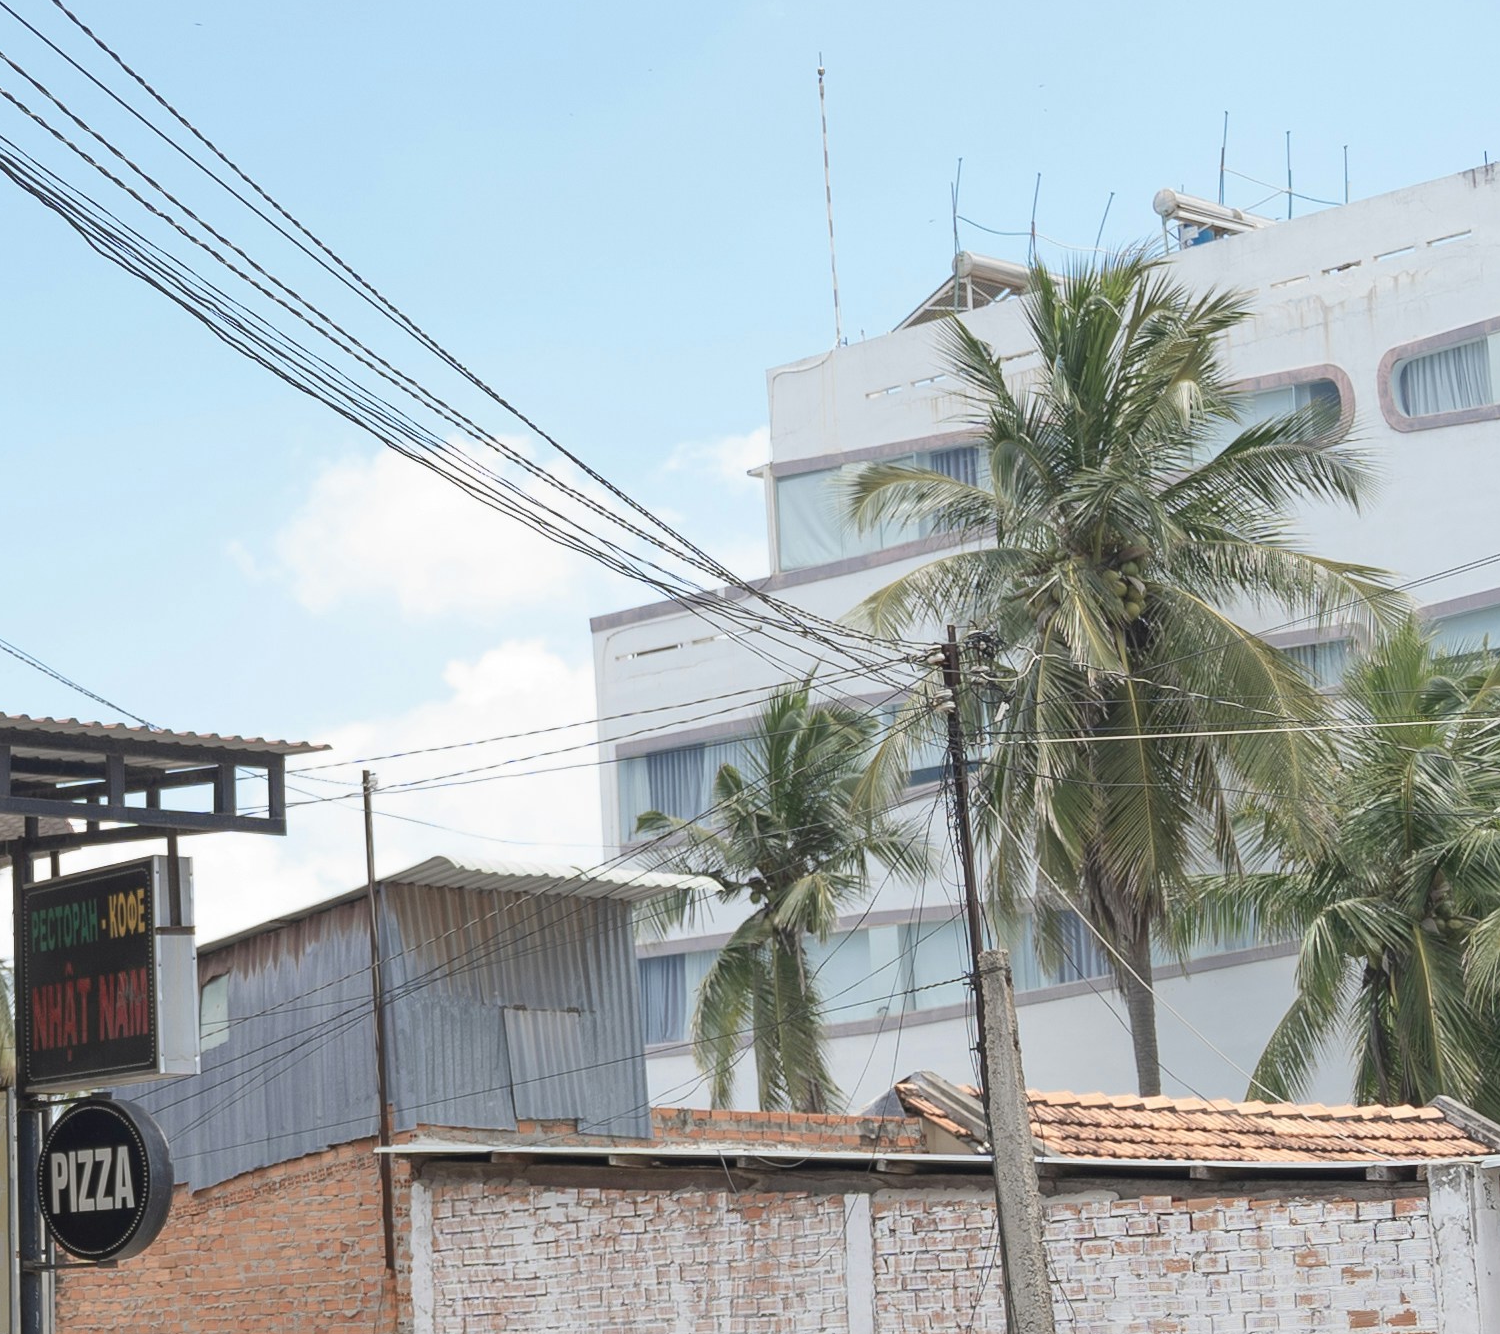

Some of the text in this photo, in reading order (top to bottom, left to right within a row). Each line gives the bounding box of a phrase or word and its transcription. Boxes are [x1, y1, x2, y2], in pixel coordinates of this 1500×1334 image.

[31, 898, 99, 954] РЕСТОРАН
[109, 888, 146, 939] КОФЕ
[32, 962, 149, 1063] NHẬT NAM
[51, 1145, 135, 1215] PIZZA
